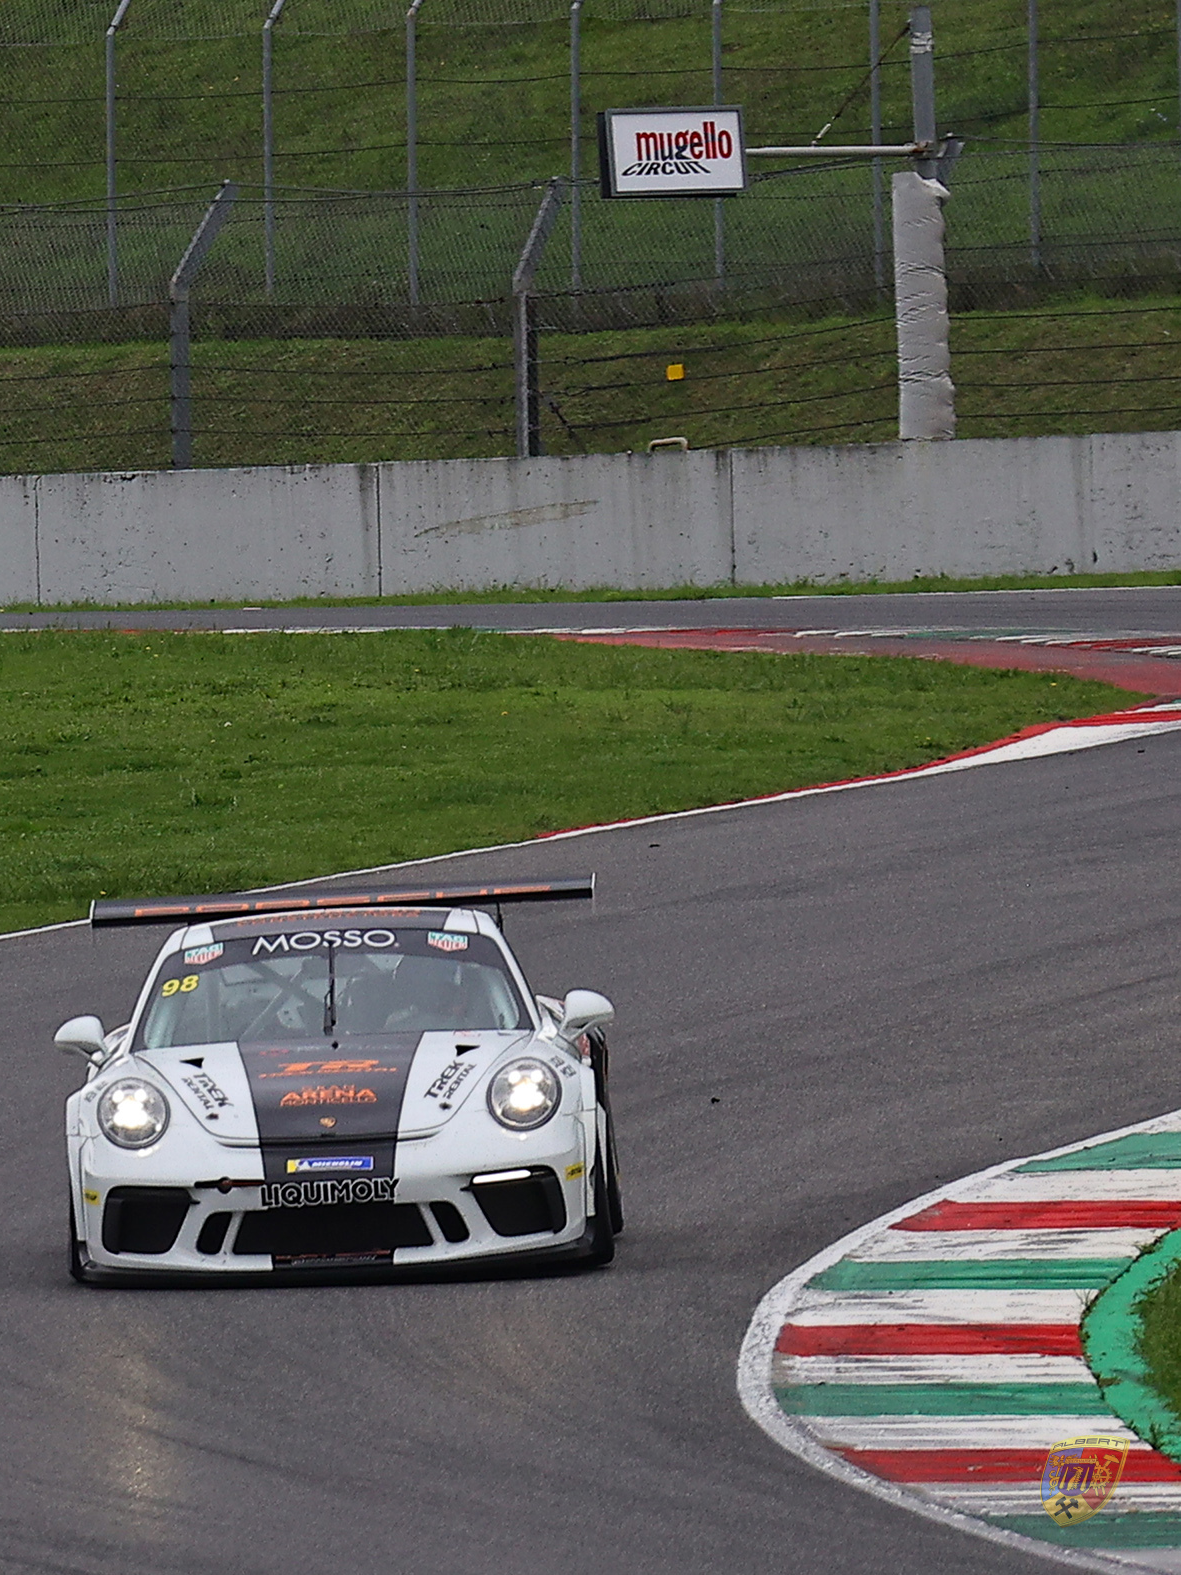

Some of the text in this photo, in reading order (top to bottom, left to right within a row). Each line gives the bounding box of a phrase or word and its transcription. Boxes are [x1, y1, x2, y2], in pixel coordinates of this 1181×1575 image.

[636, 121, 732, 161] mugello
[622, 161, 712, 176] CIRCUIT
[161, 974, 199, 997] 98
[423, 1060, 465, 1098] TREK
